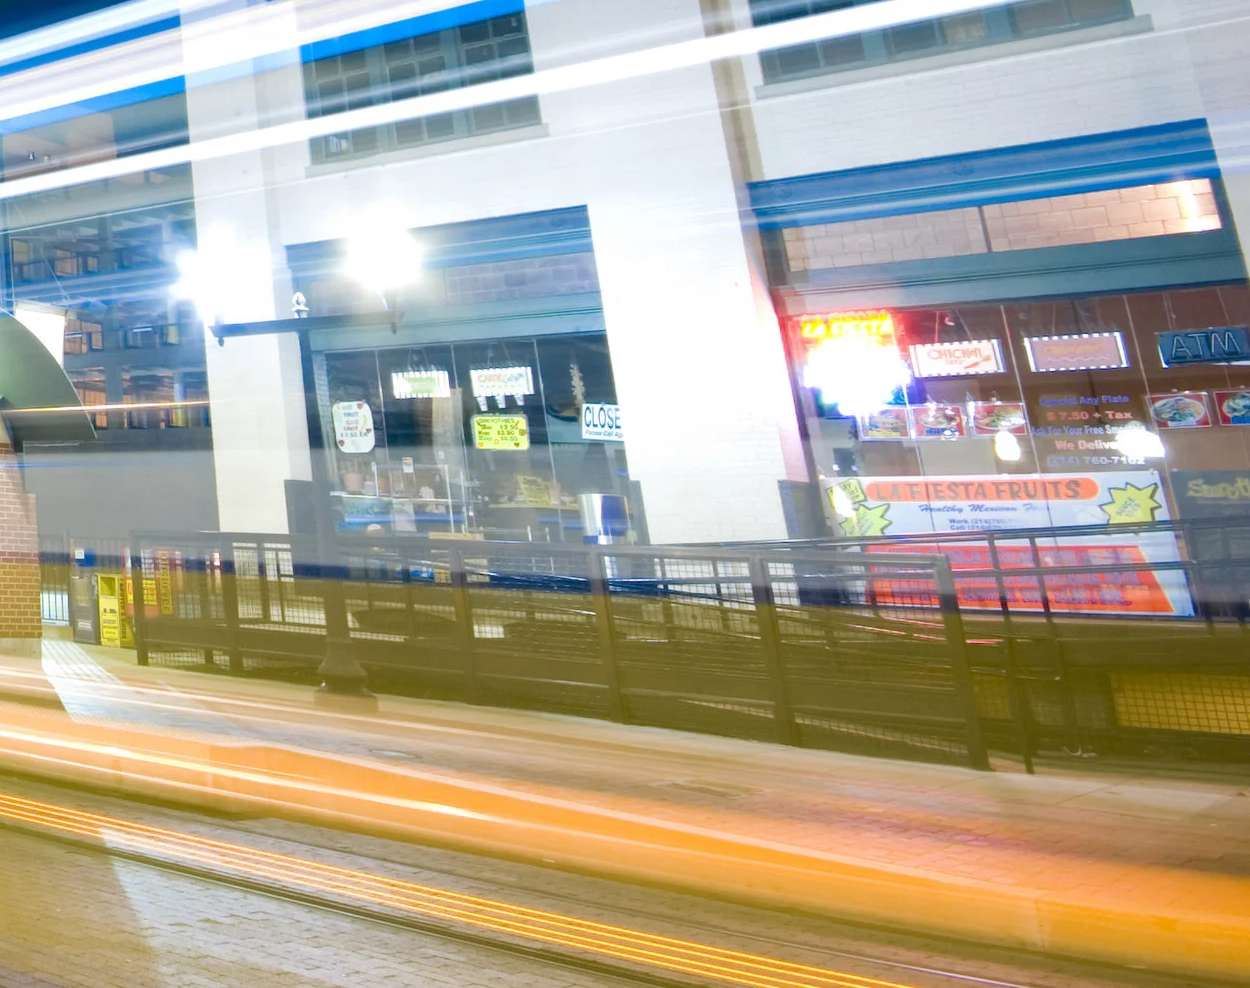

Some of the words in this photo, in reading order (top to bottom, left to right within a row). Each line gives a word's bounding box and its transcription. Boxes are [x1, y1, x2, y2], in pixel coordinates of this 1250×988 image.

[802, 320, 826, 337] LA
[830, 317, 892, 337] FIESTA
[1171, 331, 1241, 358] ATM
[1080, 396, 1099, 406] Any
[1102, 394, 1130, 404] Plate
[584, 406, 622, 429] CLOSE
[1105, 411, 1133, 420] Tax
[1063, 425, 1083, 436] Your
[1084, 425, 1104, 435] Free
[1055, 440, 1075, 450] We
[1078, 439, 1118, 450] Delive
[875, 484, 901, 500] LA
[993, 479, 1081, 500] FRUITS
[918, 503, 964, 514] Healthy
[968, 503, 1017, 513] Mexican
